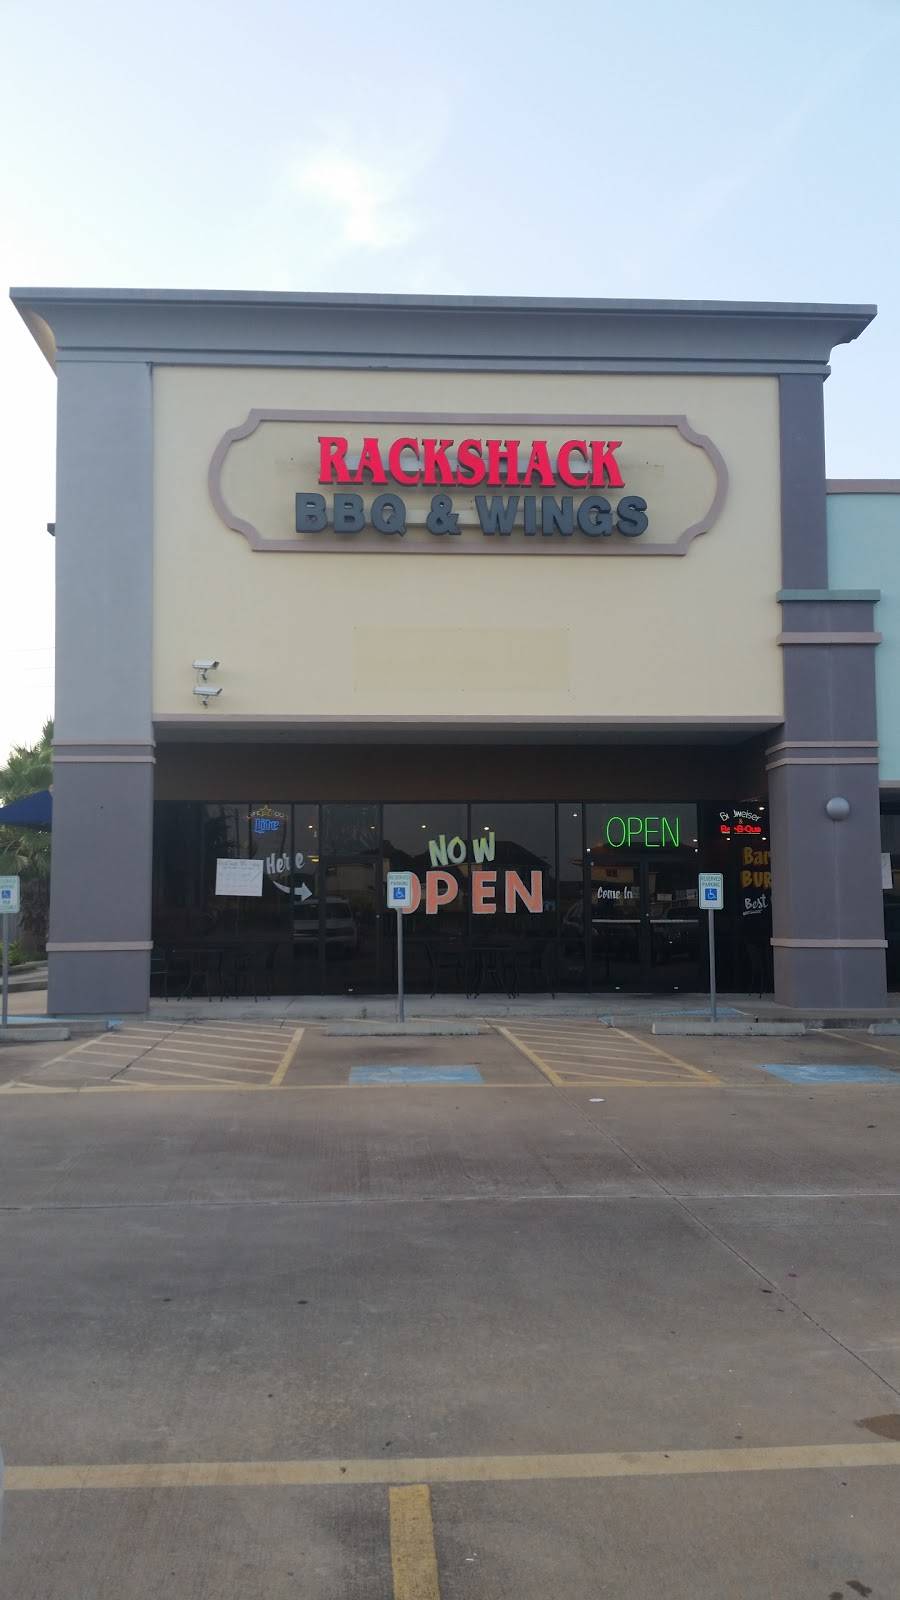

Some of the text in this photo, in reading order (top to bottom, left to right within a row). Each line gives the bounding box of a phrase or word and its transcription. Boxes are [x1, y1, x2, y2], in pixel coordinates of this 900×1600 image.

[317, 436, 625, 489] RACKSHACK
[295, 492, 649, 538] BBQ & WINGS
[606, 816, 679, 848] OPEN
[265, 852, 305, 875] Here
[428, 832, 495, 867] NOW
[597, 886, 633, 899] Come In
[744, 894, 768, 910] Best
